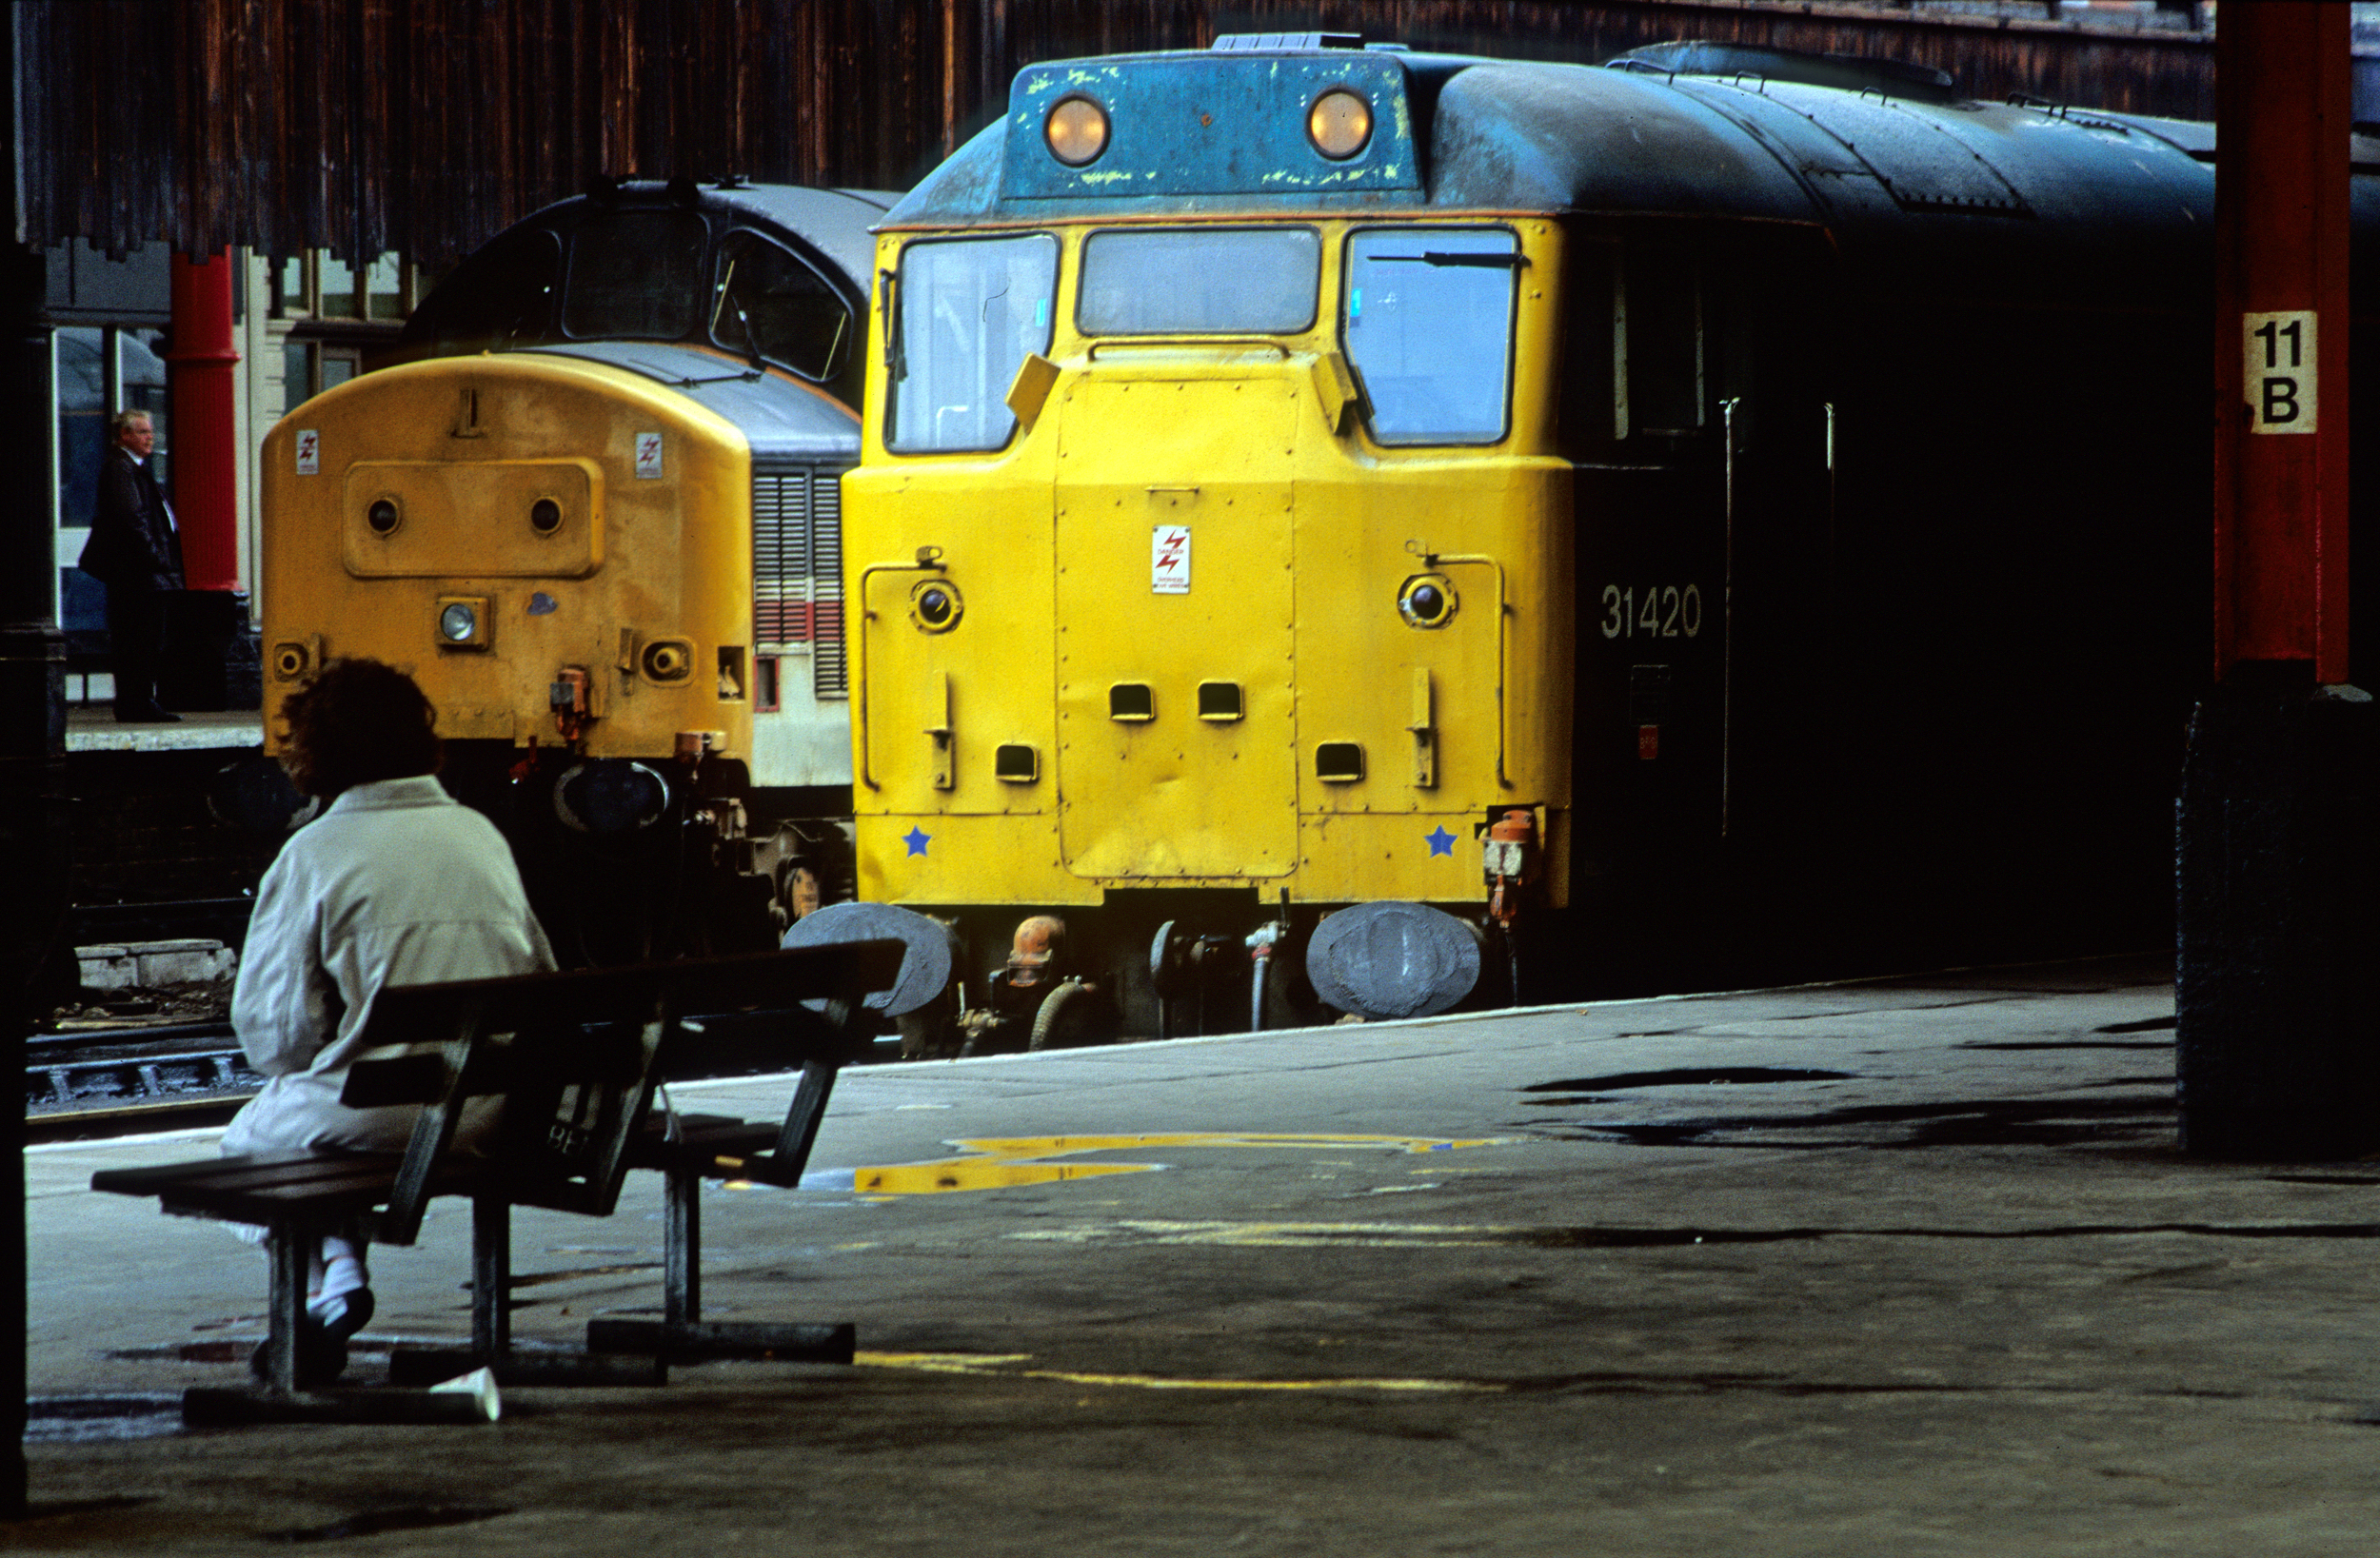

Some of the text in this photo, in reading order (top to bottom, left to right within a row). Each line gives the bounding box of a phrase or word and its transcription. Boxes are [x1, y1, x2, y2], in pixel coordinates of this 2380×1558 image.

[2253, 320, 2301, 368] 11
[2263, 377, 2299, 424] B
[1600, 582, 1702, 640] 31420
